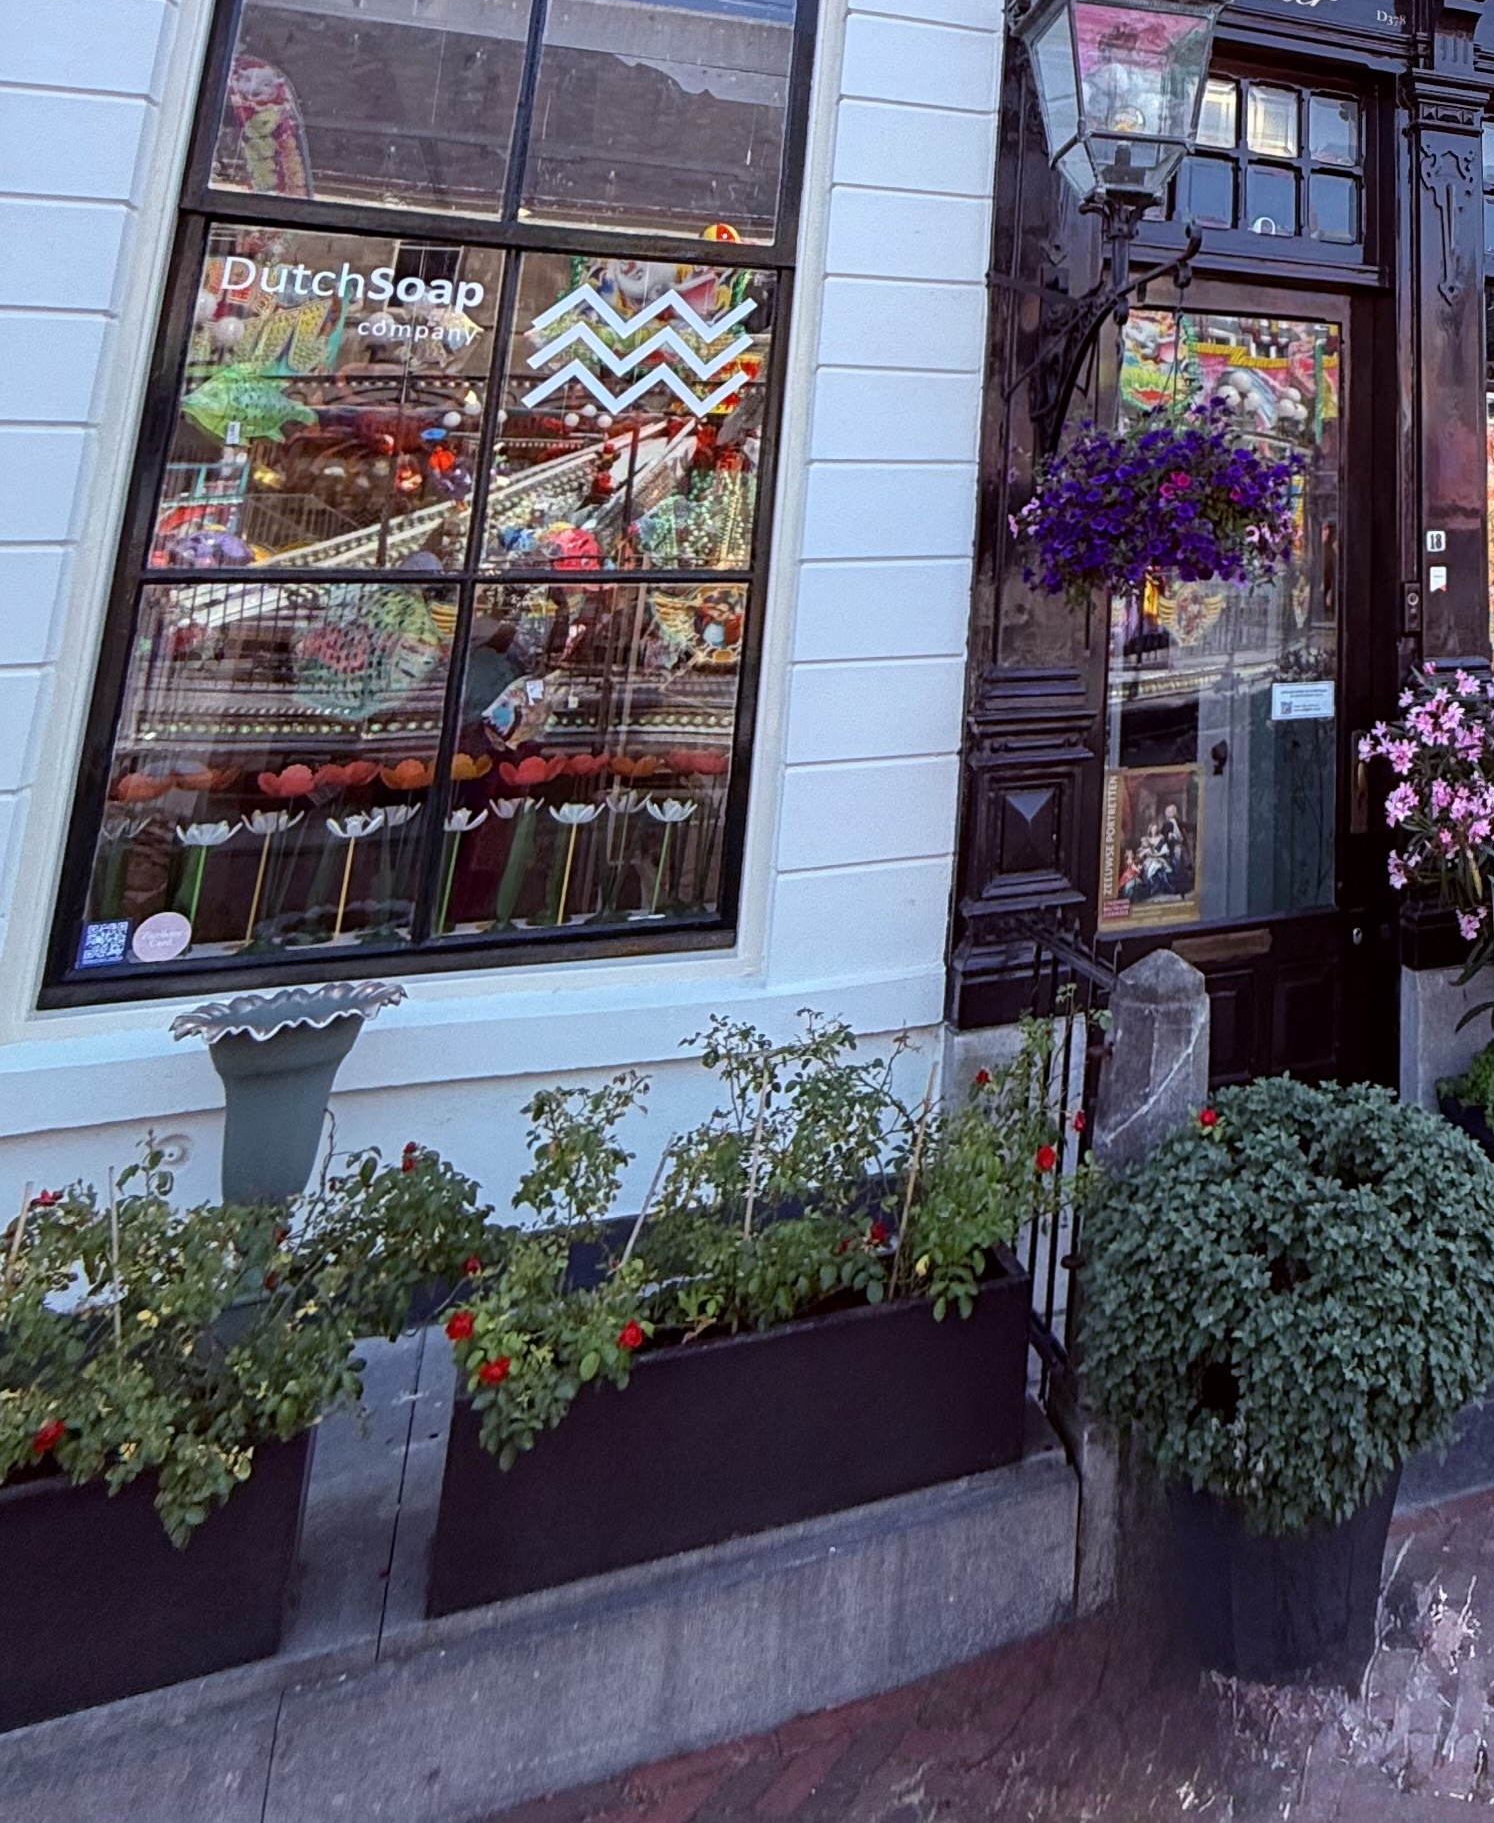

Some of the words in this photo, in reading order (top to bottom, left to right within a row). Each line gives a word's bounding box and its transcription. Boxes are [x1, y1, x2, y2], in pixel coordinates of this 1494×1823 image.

[1376, 10, 1407, 26] D378
[220, 256, 485, 314] DutchSoap
[357, 320, 479, 345] company
[1430, 533, 1442, 550] 18
[1106, 775, 1118, 842] PORTRETTEN
[1104, 845, 1115, 896] ZEEUWSE
